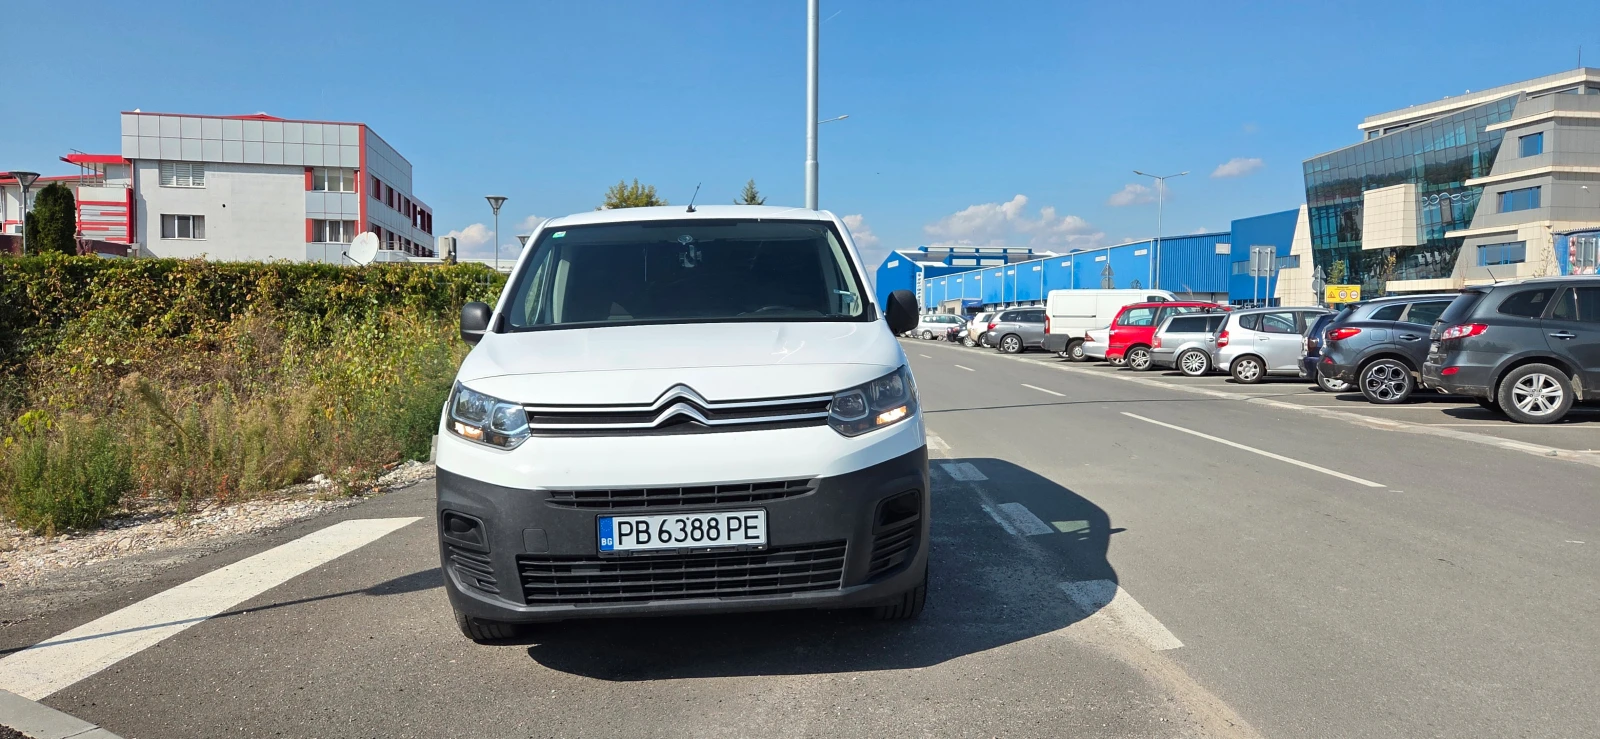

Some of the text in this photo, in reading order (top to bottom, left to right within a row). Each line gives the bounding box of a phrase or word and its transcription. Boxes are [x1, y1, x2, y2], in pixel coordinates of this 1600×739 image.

[618, 515, 760, 545] PB 6388 PE
[601, 538, 612, 546] BG
